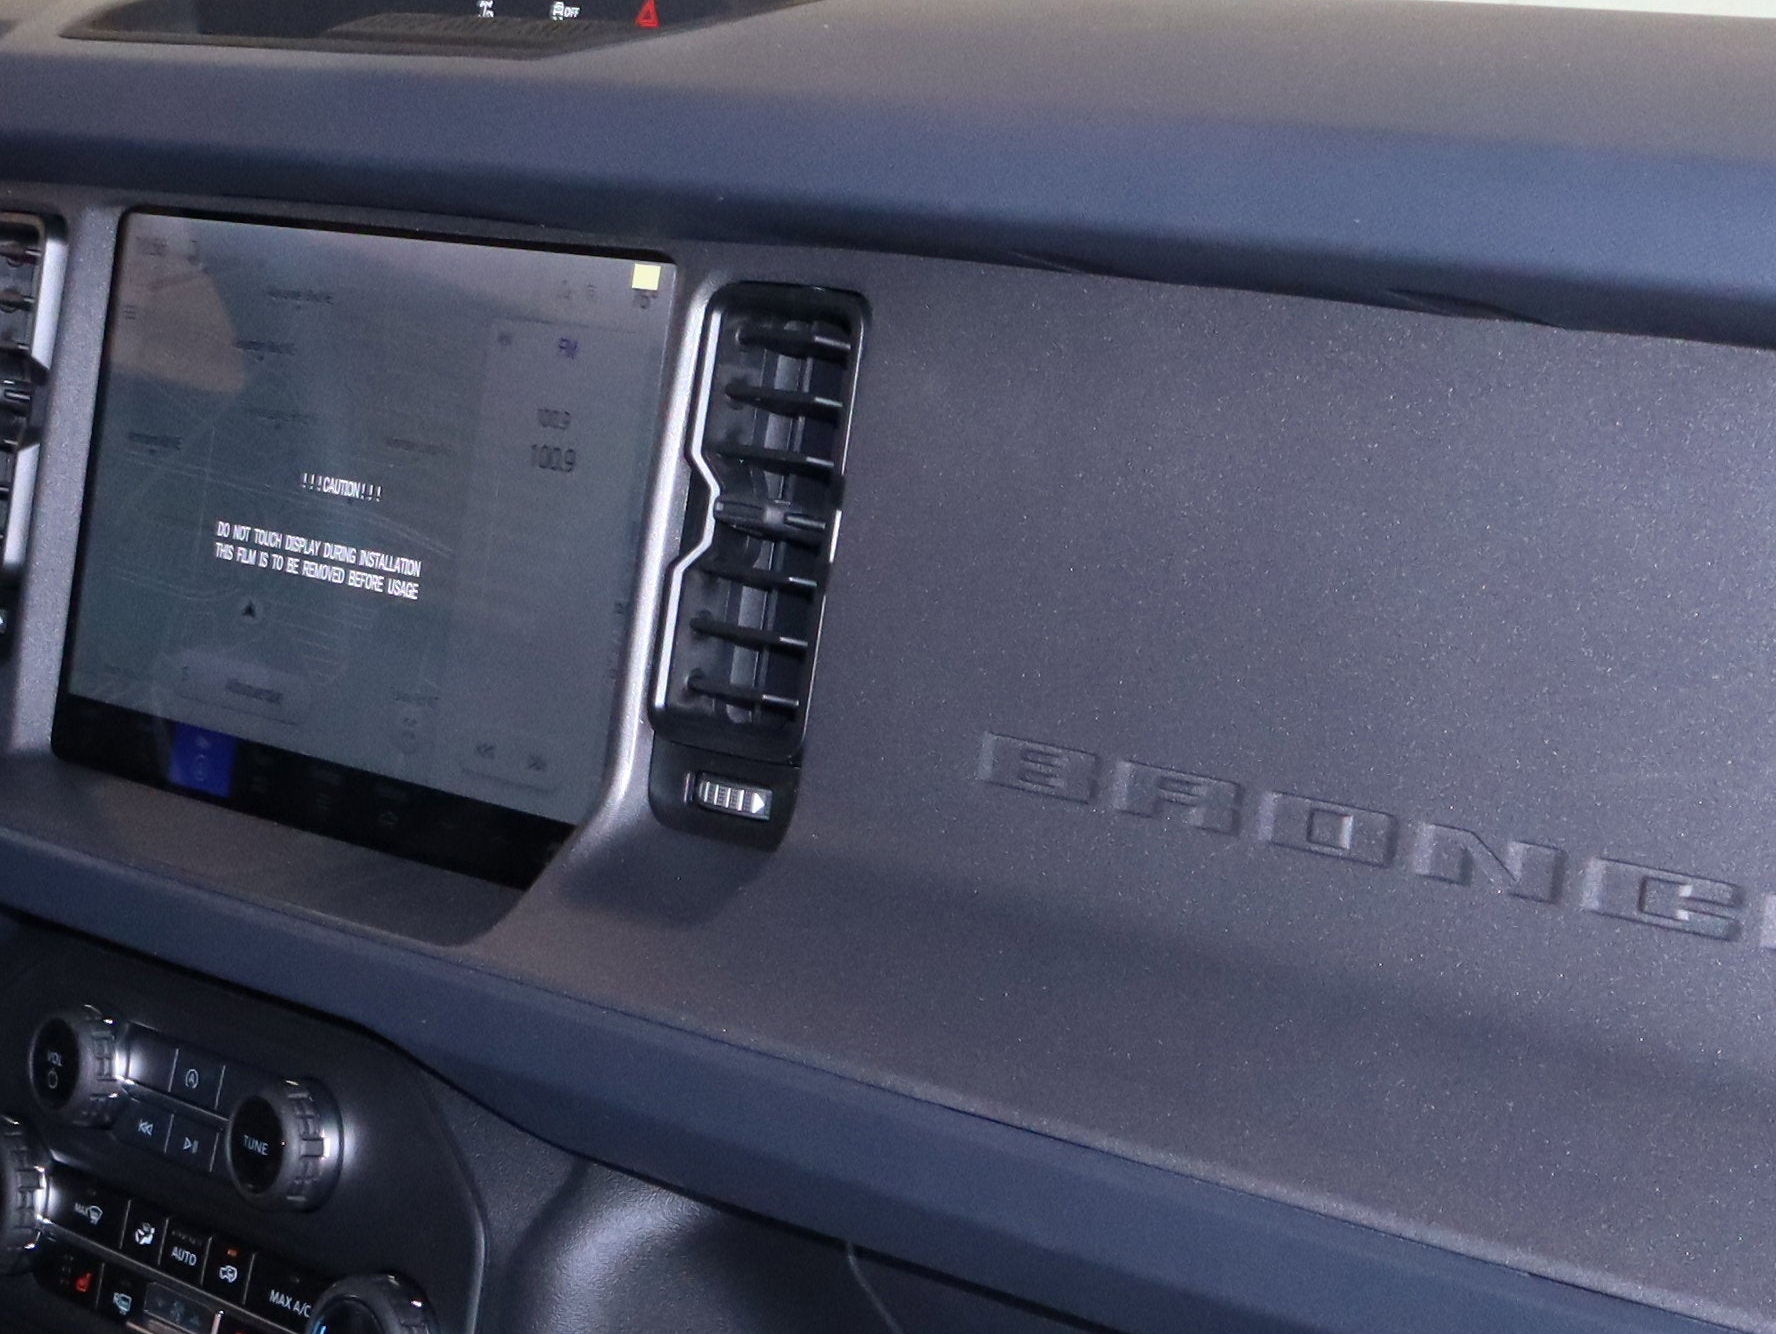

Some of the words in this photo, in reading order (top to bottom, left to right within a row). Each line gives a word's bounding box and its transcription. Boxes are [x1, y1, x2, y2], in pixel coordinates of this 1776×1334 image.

[217, 521, 230, 537] DO
[233, 524, 251, 542] NOT
[255, 528, 282, 549] TOUCH
[285, 534, 322, 557] DISPLAY
[324, 542, 356, 564] DURING
[360, 549, 422, 578] INSTALLATION
[215, 542, 234, 561] THIS
[236, 546, 256, 566] FILM
[258, 550, 269, 568] IS
[272, 553, 284, 571] TO
[286, 557, 300, 575] BE
[302, 560, 345, 585] REMOVED
[348, 570, 385, 593] BEFORE
[388, 578, 419, 600] USAGE
[243, 1134, 269, 1156] TUNE
[170, 1246, 198, 1266] AUTO
[269, 1289, 292, 1311] MAX
[293, 1300, 312, 1319] A/C
